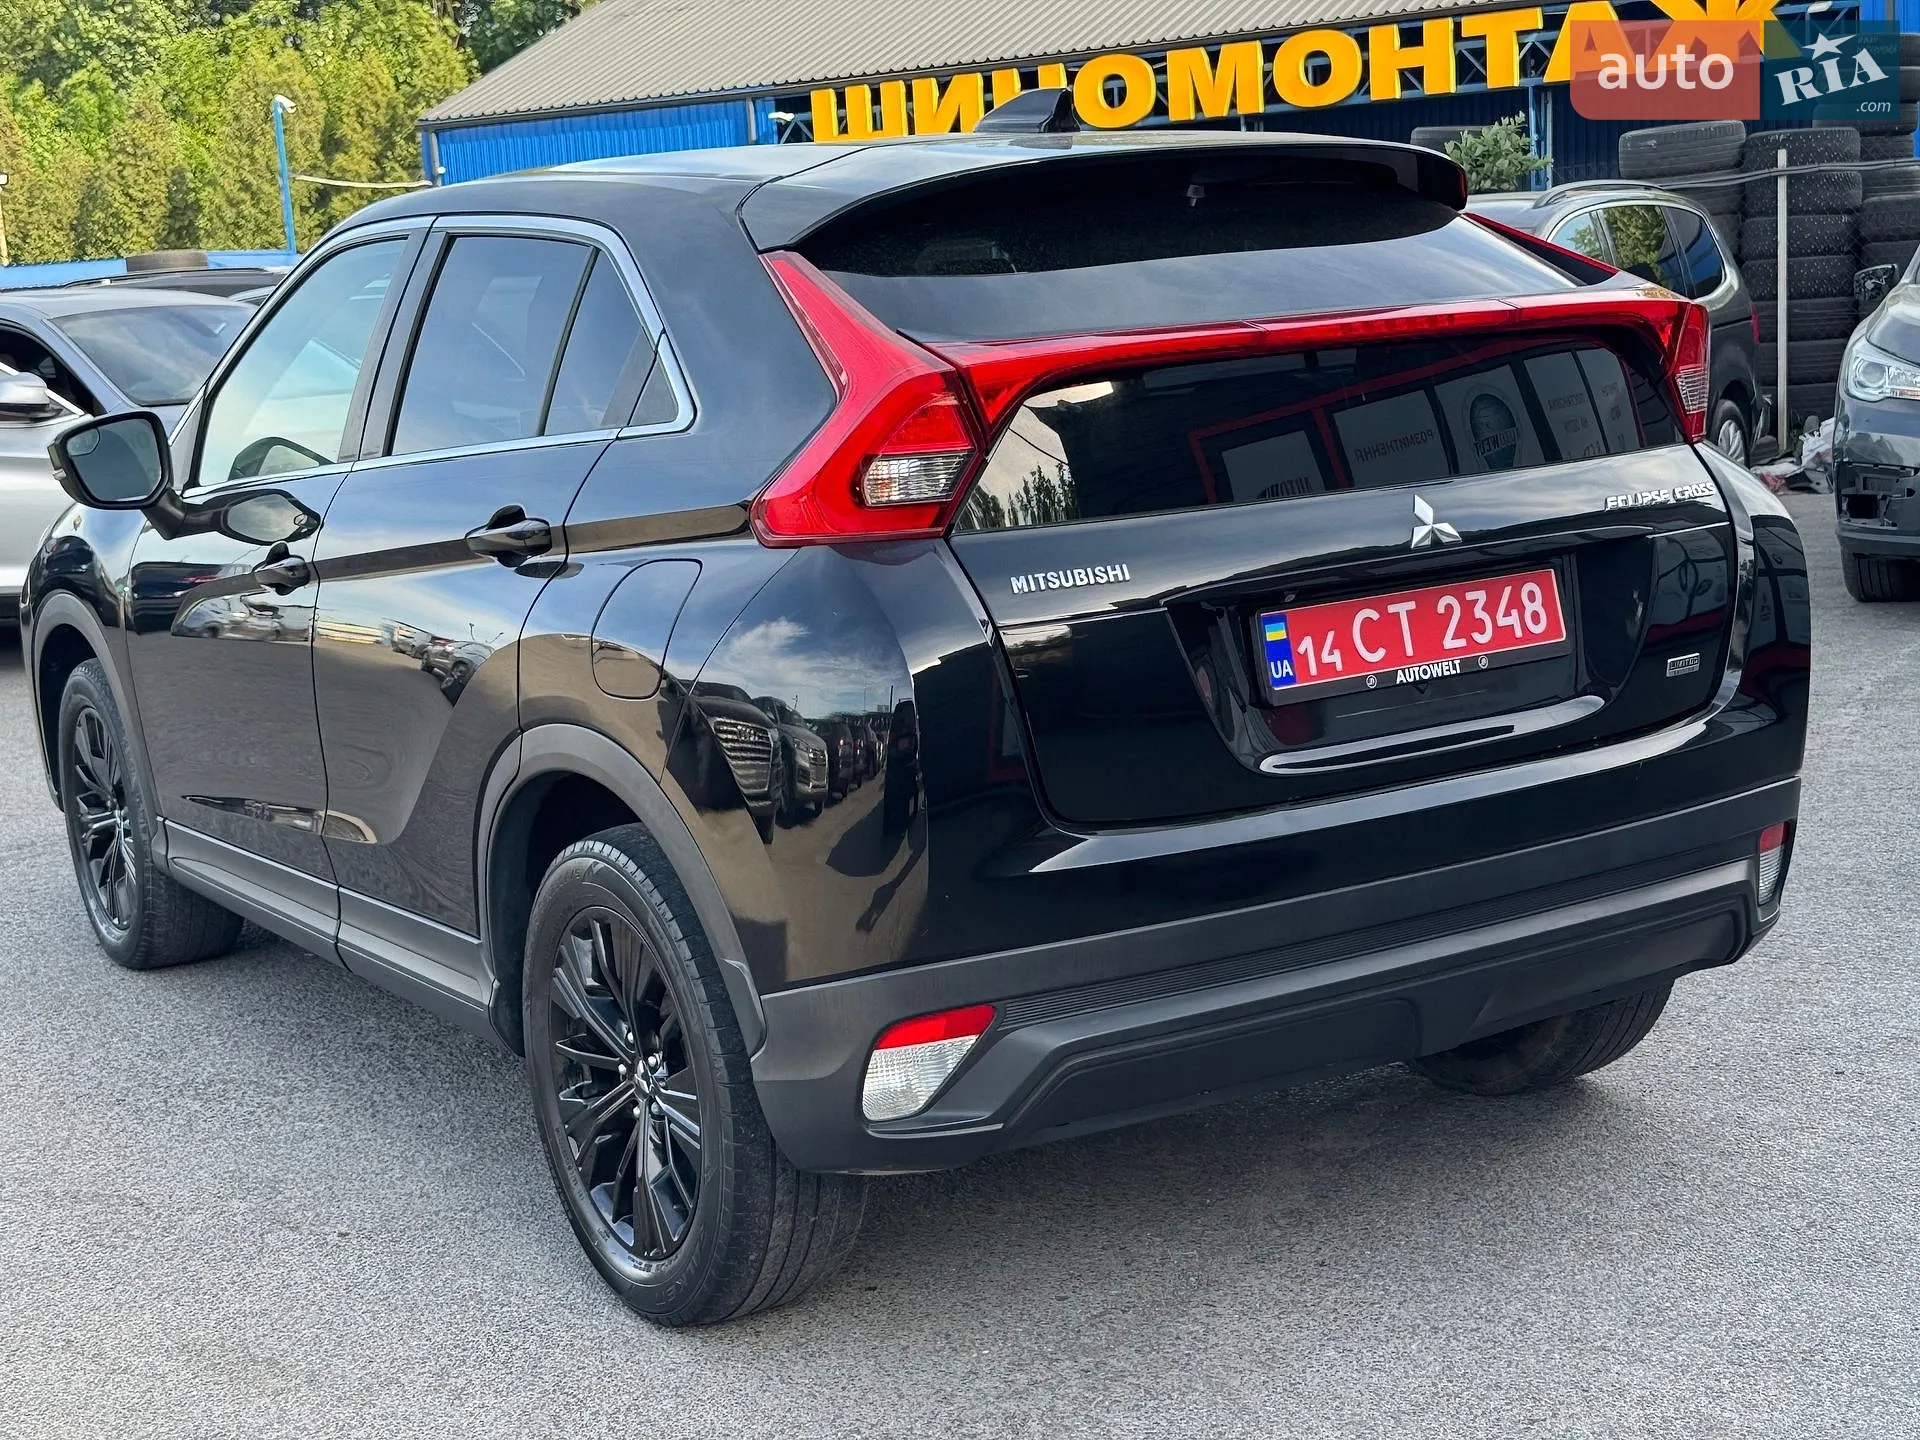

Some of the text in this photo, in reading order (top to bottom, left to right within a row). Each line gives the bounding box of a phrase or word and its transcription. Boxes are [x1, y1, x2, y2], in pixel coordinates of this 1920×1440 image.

[1604, 482, 1717, 512] ECLIPSE CROSS
[1010, 563, 1131, 594] MITSUBISHI
[1296, 581, 1548, 676] 14 CT 2348
[1270, 658, 1294, 679] UA
[1396, 659, 1461, 684] AUTOWELT
